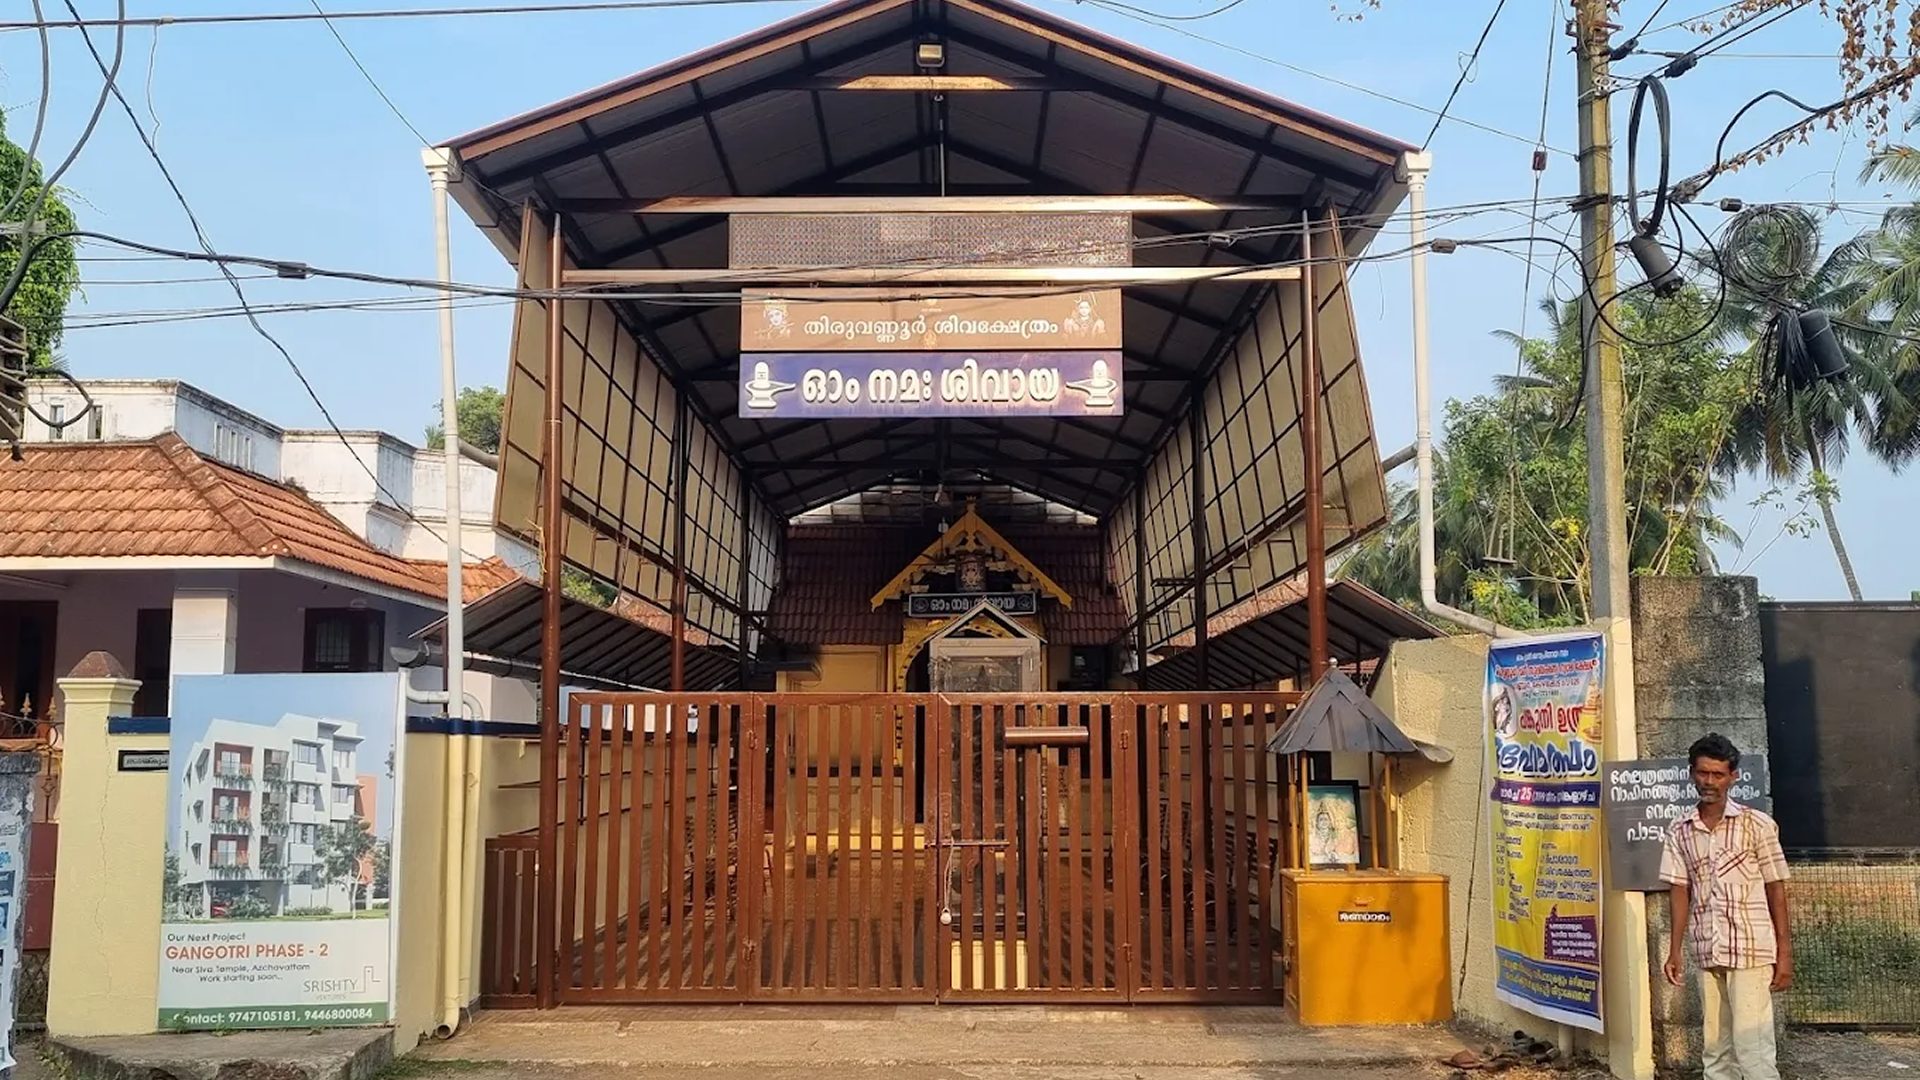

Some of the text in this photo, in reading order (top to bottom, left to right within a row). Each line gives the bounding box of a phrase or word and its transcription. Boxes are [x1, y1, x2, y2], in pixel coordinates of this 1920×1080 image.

[804, 314, 1059, 342] തിരുവണ്ണൂർ ശിവക്ഷേത്രം
[803, 358, 1060, 402] ഓം നമഃ ശിവായ
[1520, 786, 1532, 800] 25
[167, 932, 246, 942] Our Next Project
[166, 946, 250, 960] GANGOTRI
[256, 944, 304, 958] PHASE
[319, 944, 328, 957] 2
[172, 966, 193, 974] Near
[196, 965, 213, 974] Siva
[216, 965, 250, 974] Temple,
[200, 975, 221, 983] Work
[223, 974, 256, 983] starting
[303, 979, 357, 993] SRISHTY
[228, 1010, 301, 1023] 9747105181,
[304, 1007, 373, 1021] 9446800084
